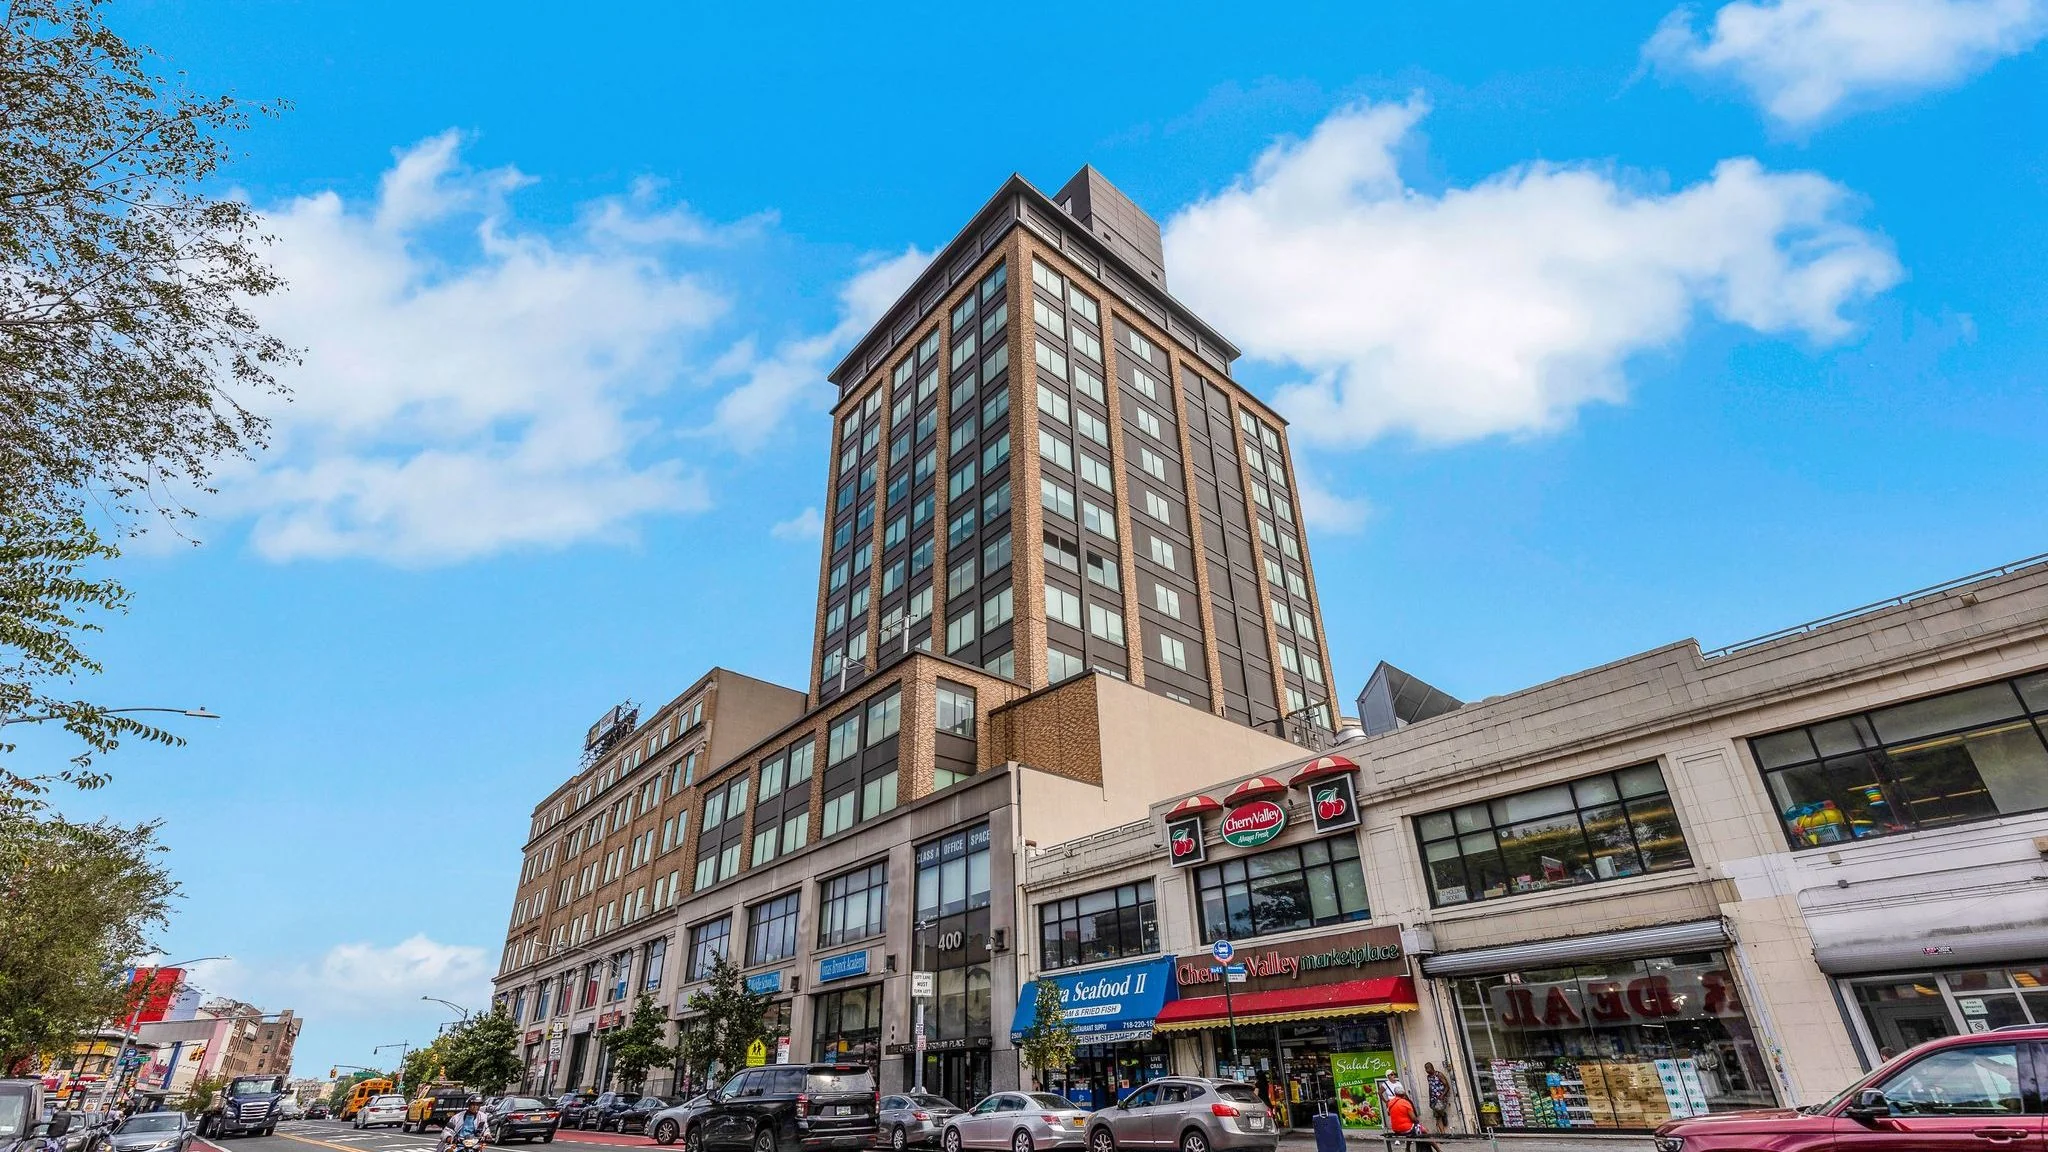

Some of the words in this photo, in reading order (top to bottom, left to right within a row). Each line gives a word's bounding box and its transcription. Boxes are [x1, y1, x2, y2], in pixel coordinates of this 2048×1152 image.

[1225, 808, 1279, 831] CherryValley
[1255, 830, 1270, 840] Fresh
[916, 847, 934, 864] CLASS
[935, 847, 940, 859] A
[943, 839, 963, 855] OFFICE
[970, 829, 991, 846] SPACE
[938, 930, 962, 951] 400
[1245, 951, 1300, 980] Valley
[1301, 942, 1399, 970] marketplace
[1073, 975, 1131, 1001] Seafood
[1062, 1009, 1074, 1018] EAM
[1075, 1008, 1080, 1017] &
[1080, 1007, 1100, 1016] FRIED
[1101, 1006, 1117, 1014] FISH
[1094, 1023, 1107, 1032] SUPPLY
[948, 1038, 965, 1048] PLACE
[1336, 1056, 1371, 1073] Salad
[1370, 1057, 1391, 1072] Bar
